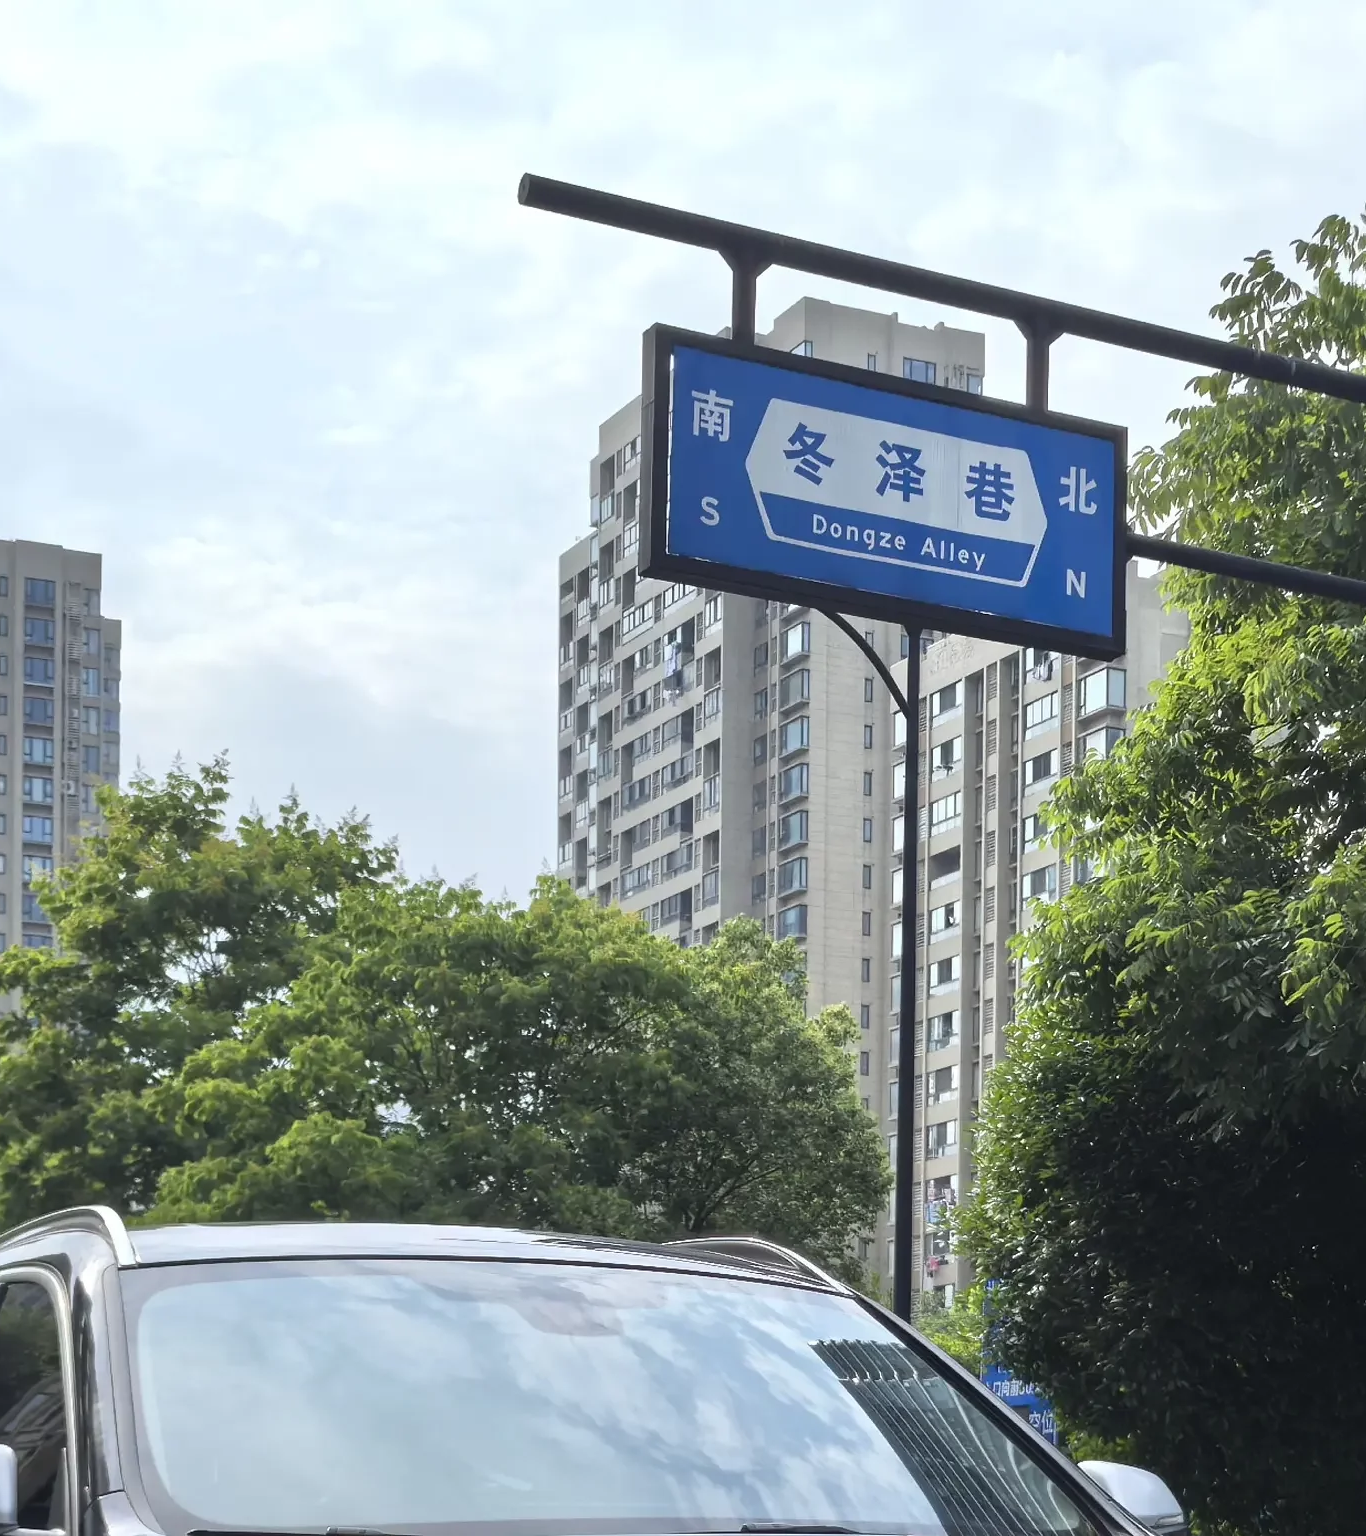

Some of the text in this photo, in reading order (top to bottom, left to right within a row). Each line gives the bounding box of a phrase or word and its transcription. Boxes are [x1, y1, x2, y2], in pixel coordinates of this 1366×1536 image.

[691, 388, 734, 442] 南
[782, 421, 1015, 522] 冬泽巷
[1058, 466, 1098, 515] 北
[699, 496, 720, 526] S
[811, 513, 986, 571] Dongze Alley
[1066, 568, 1087, 599] N
